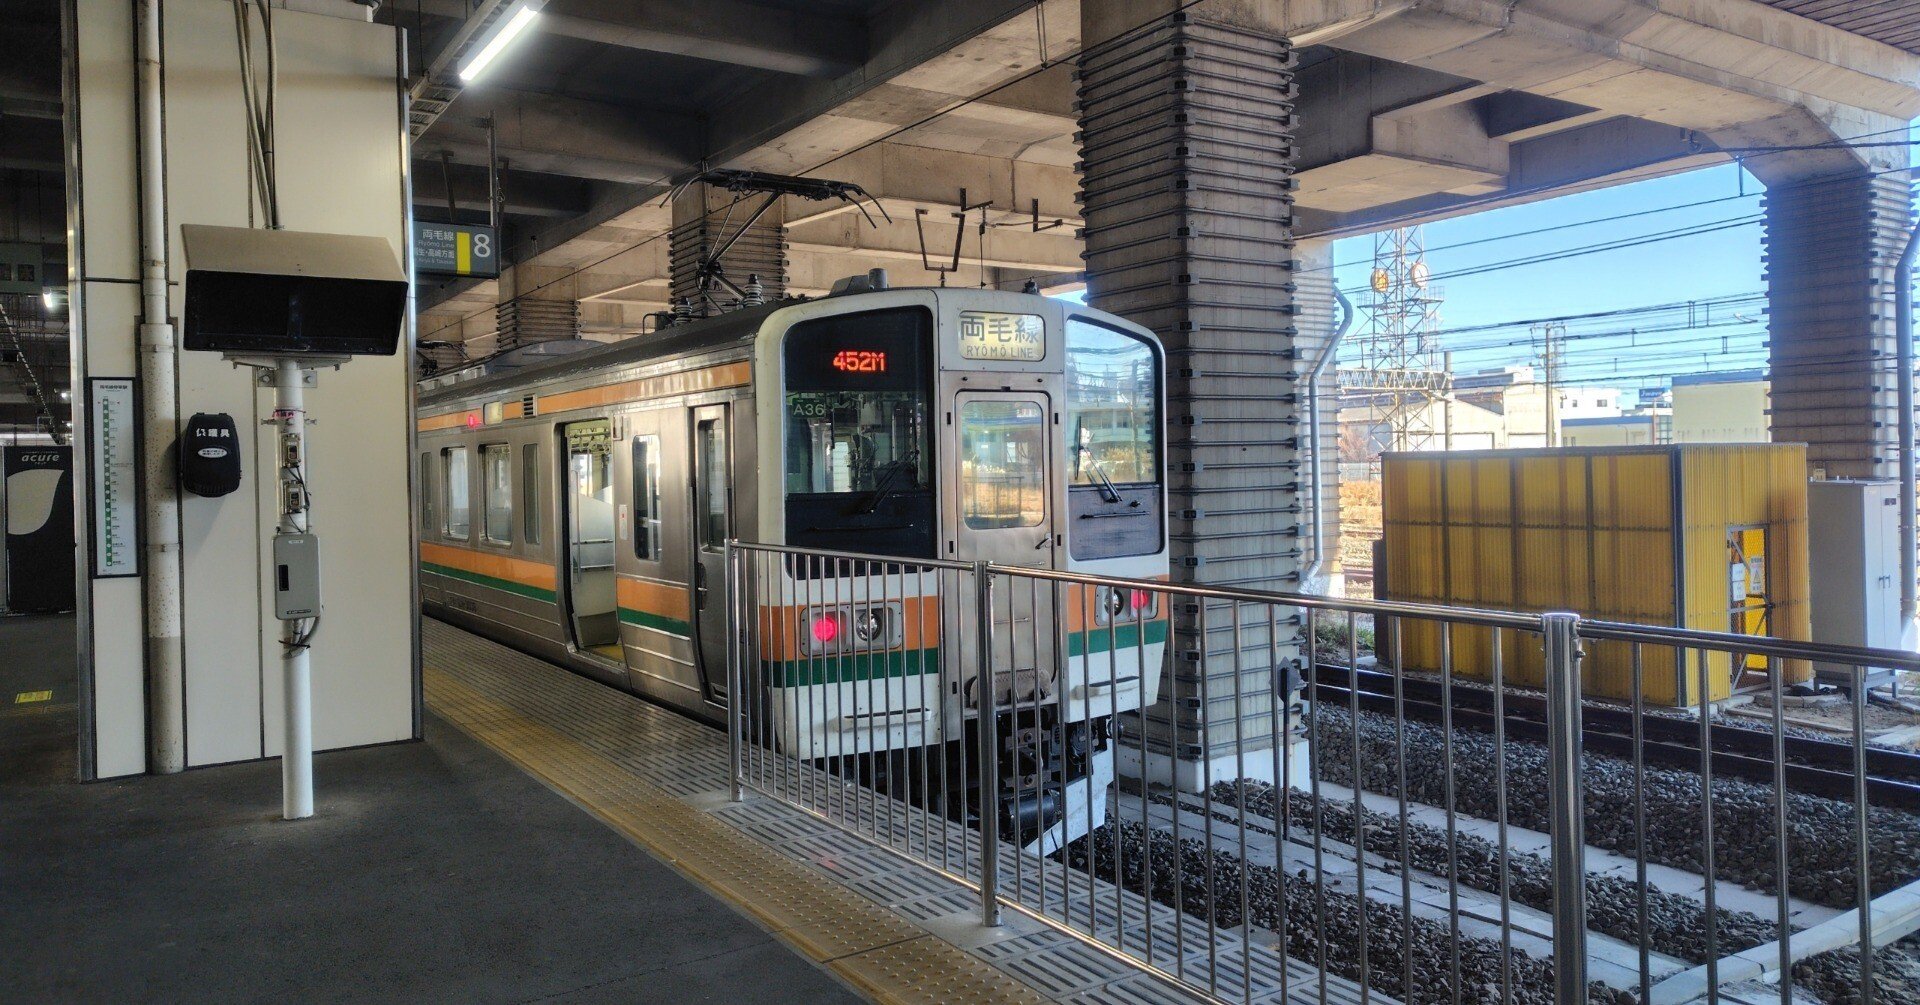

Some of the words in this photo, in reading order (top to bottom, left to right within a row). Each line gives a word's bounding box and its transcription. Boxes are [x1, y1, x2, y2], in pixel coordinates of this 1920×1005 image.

[422, 229, 455, 241] 両毛線
[474, 234, 491, 257] 8
[959, 315, 1039, 343] 両毛線
[1010, 345, 1034, 359] LINE
[833, 351, 884, 371] 452M
[793, 403, 825, 416] A36
[21, 454, 60, 462] acure
